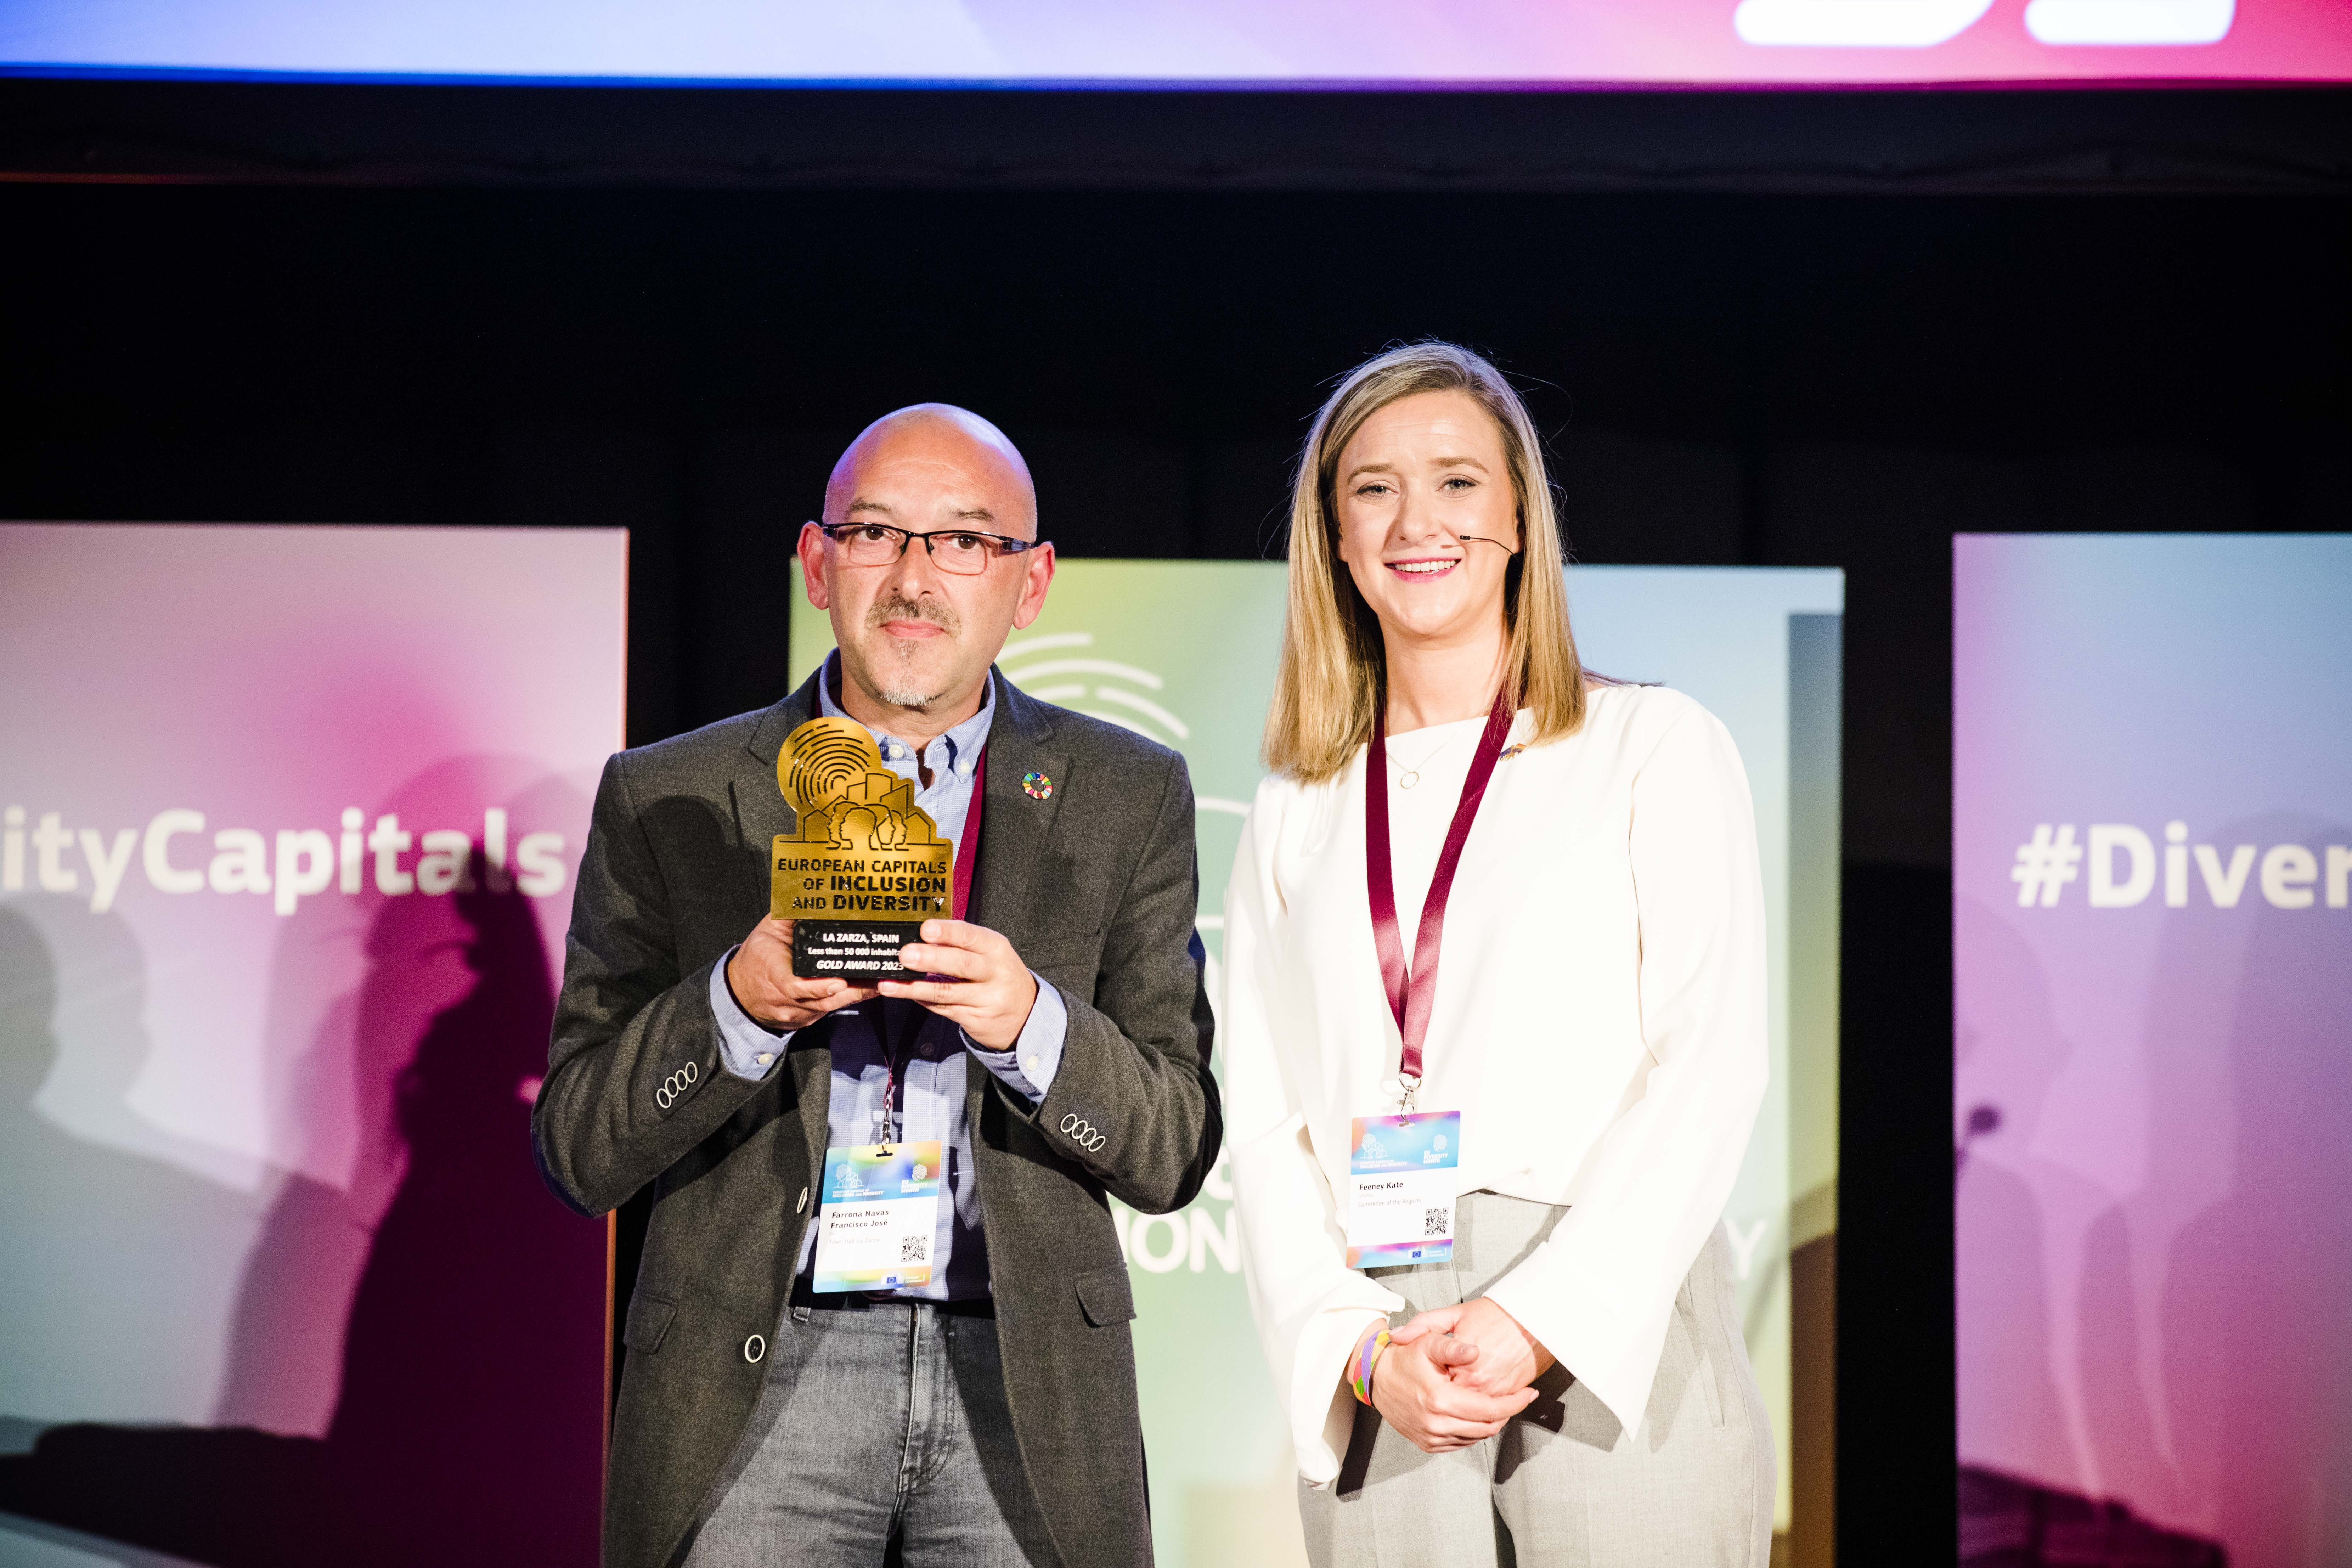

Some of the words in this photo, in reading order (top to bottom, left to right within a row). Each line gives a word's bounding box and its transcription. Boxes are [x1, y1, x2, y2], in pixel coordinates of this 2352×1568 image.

[778, 859, 864, 872] EUROPEAN
[872, 860, 947, 874] CAPITALS
[2010, 820, 2352, 909] #Diver
[803, 878, 824, 890] OF
[831, 875, 946, 892] INCLUSION
[792, 897, 826, 909] AND
[833, 895, 946, 912] DIVERSITY
[823, 933, 835, 942] LA
[836, 933, 870, 944] ZARZA,
[872, 934, 899, 943] SPAIN
[808, 947, 825, 955] Less
[816, 960, 844, 969] GOLD
[844, 961, 881, 970] AWARD
[881, 961, 904, 971] 2023
